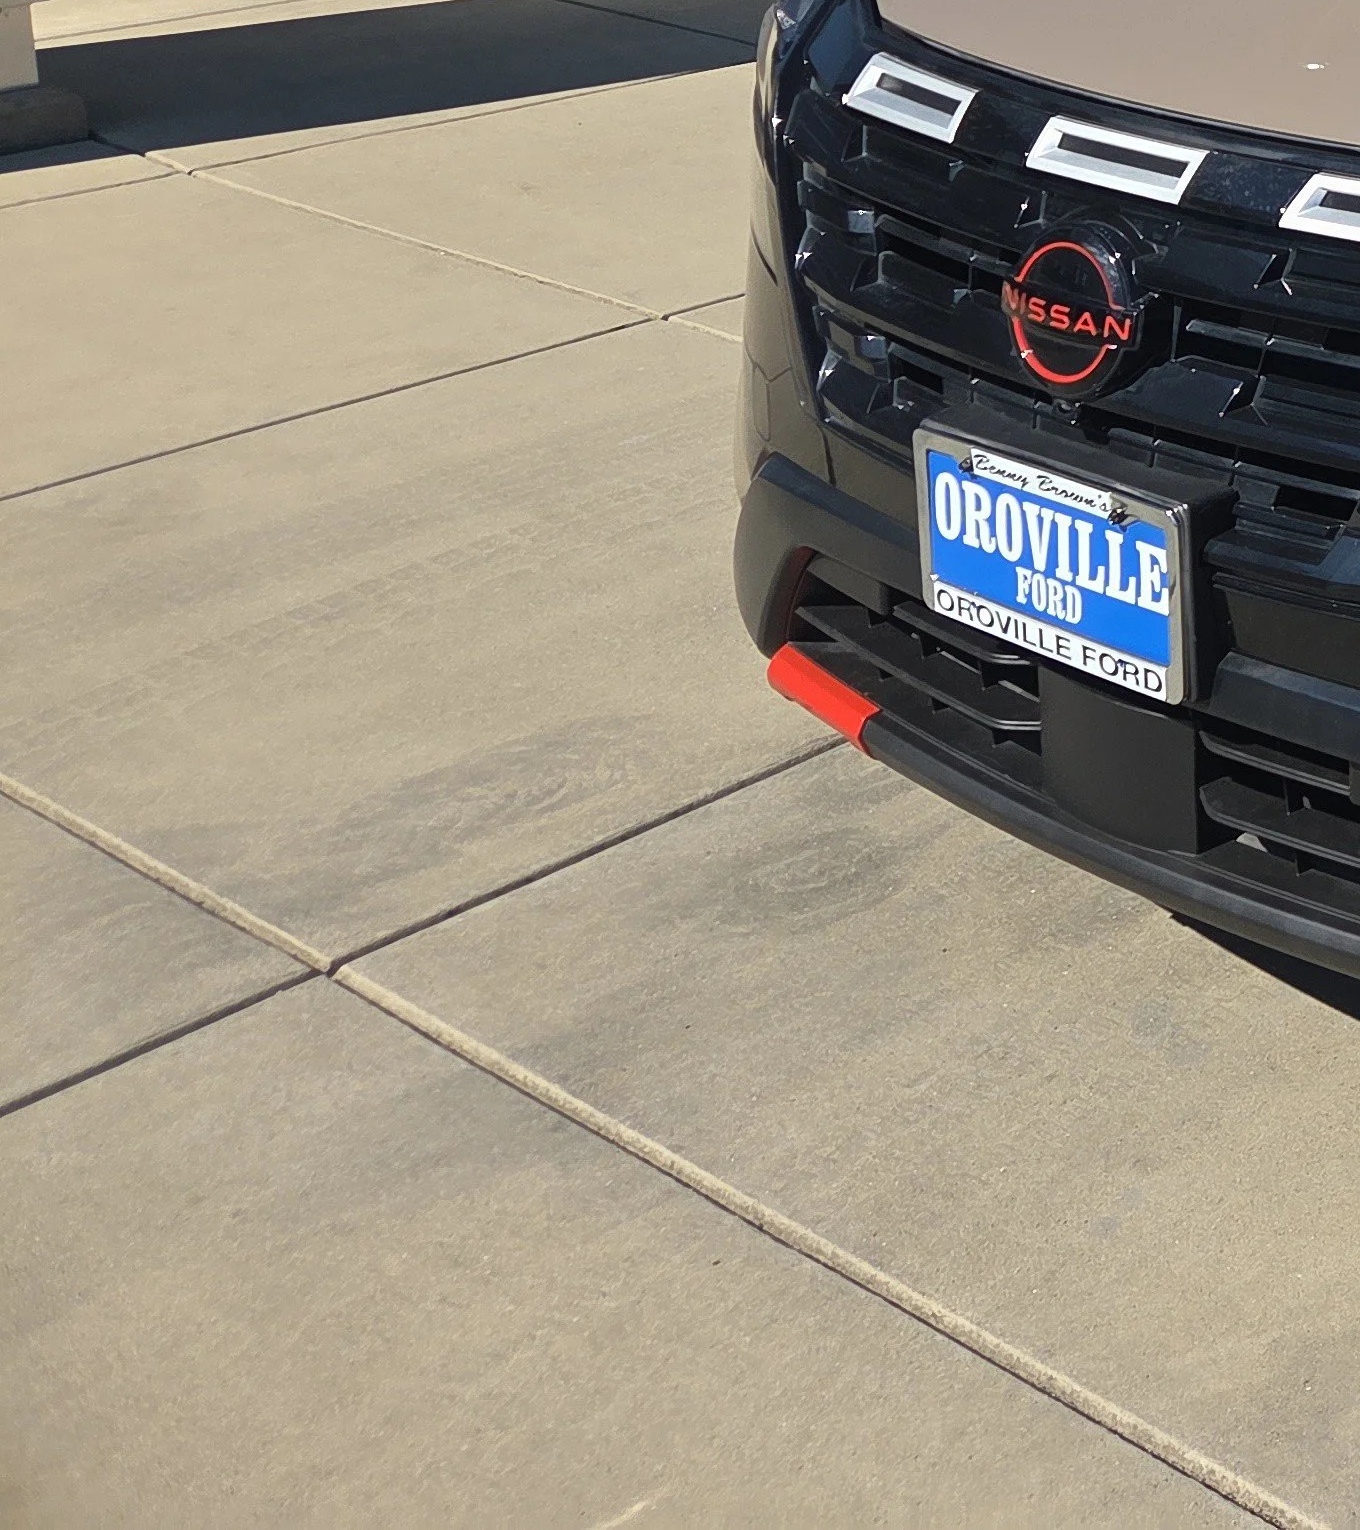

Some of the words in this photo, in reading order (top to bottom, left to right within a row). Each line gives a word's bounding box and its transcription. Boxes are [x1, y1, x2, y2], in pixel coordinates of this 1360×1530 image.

[1003, 282, 1130, 340] NISSAN
[973, 454, 1029, 490] Benny
[1036, 474, 1108, 512] Brown's
[935, 472, 1170, 616] OROVILLE
[1016, 566, 1083, 624] FORD
[936, 588, 1071, 660] OROVILLE
[1082, 644, 1163, 692] FORD
